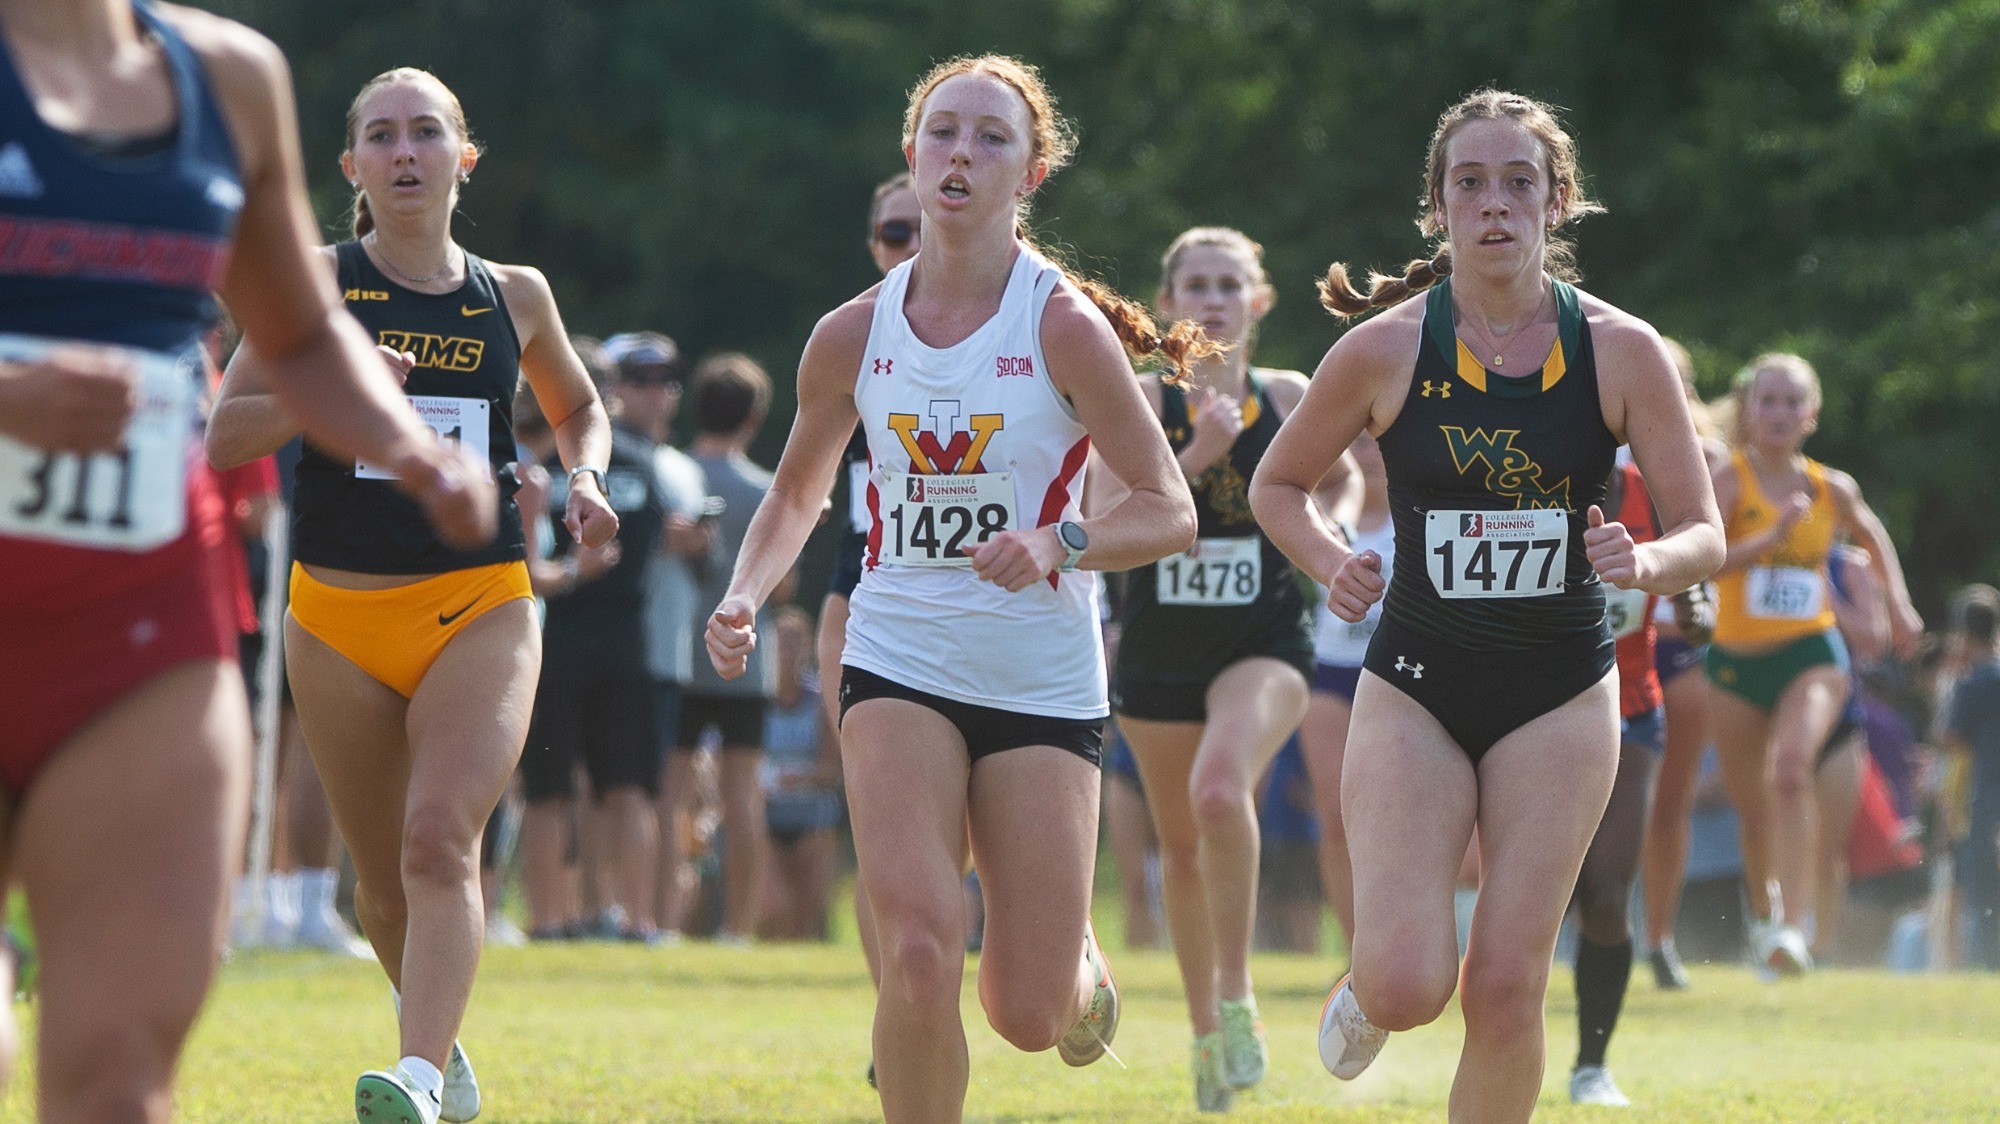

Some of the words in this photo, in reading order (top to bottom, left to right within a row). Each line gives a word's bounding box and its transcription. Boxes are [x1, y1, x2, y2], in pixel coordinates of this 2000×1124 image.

[415, 406, 460, 416] RUNNING
[926, 486, 977, 496] RUNNING
[890, 503, 1009, 559] 1428
[1485, 520, 1536, 530] RUNNING
[1433, 538, 1562, 592] 1477
[1165, 559, 1255, 598] 1478
